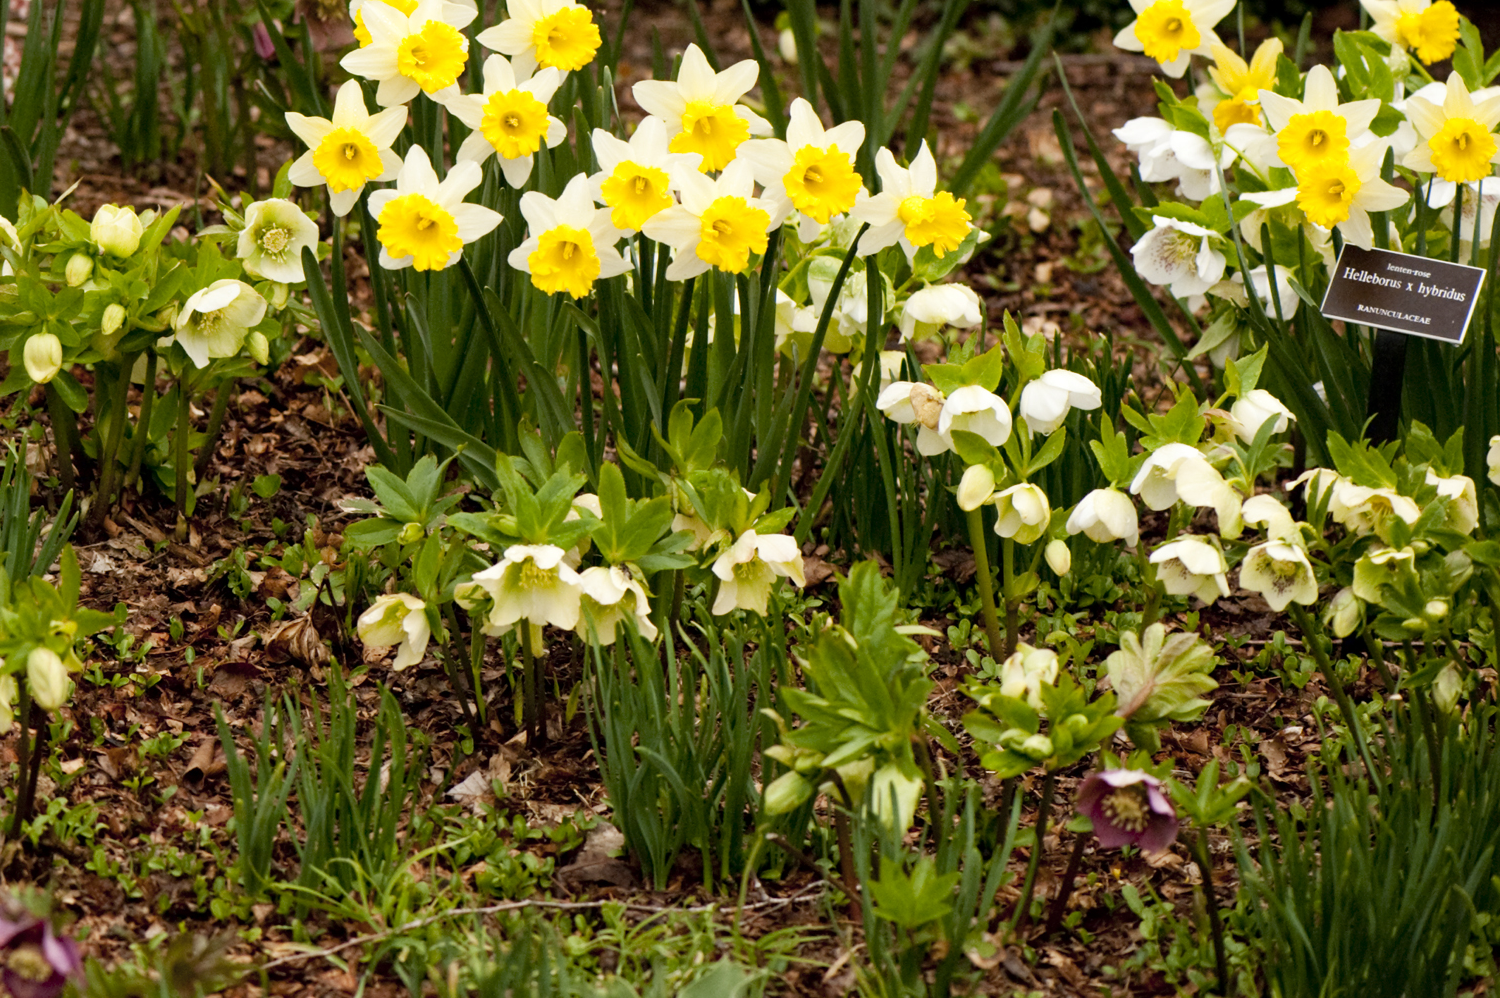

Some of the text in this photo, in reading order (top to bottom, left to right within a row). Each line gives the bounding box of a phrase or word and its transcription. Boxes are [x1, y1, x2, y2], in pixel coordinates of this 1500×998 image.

[1386, 262, 1431, 279] lenten-rose
[1342, 267, 1466, 302] Helleborus x hybridus
[1357, 304, 1431, 325] RANUNCULACEAE
